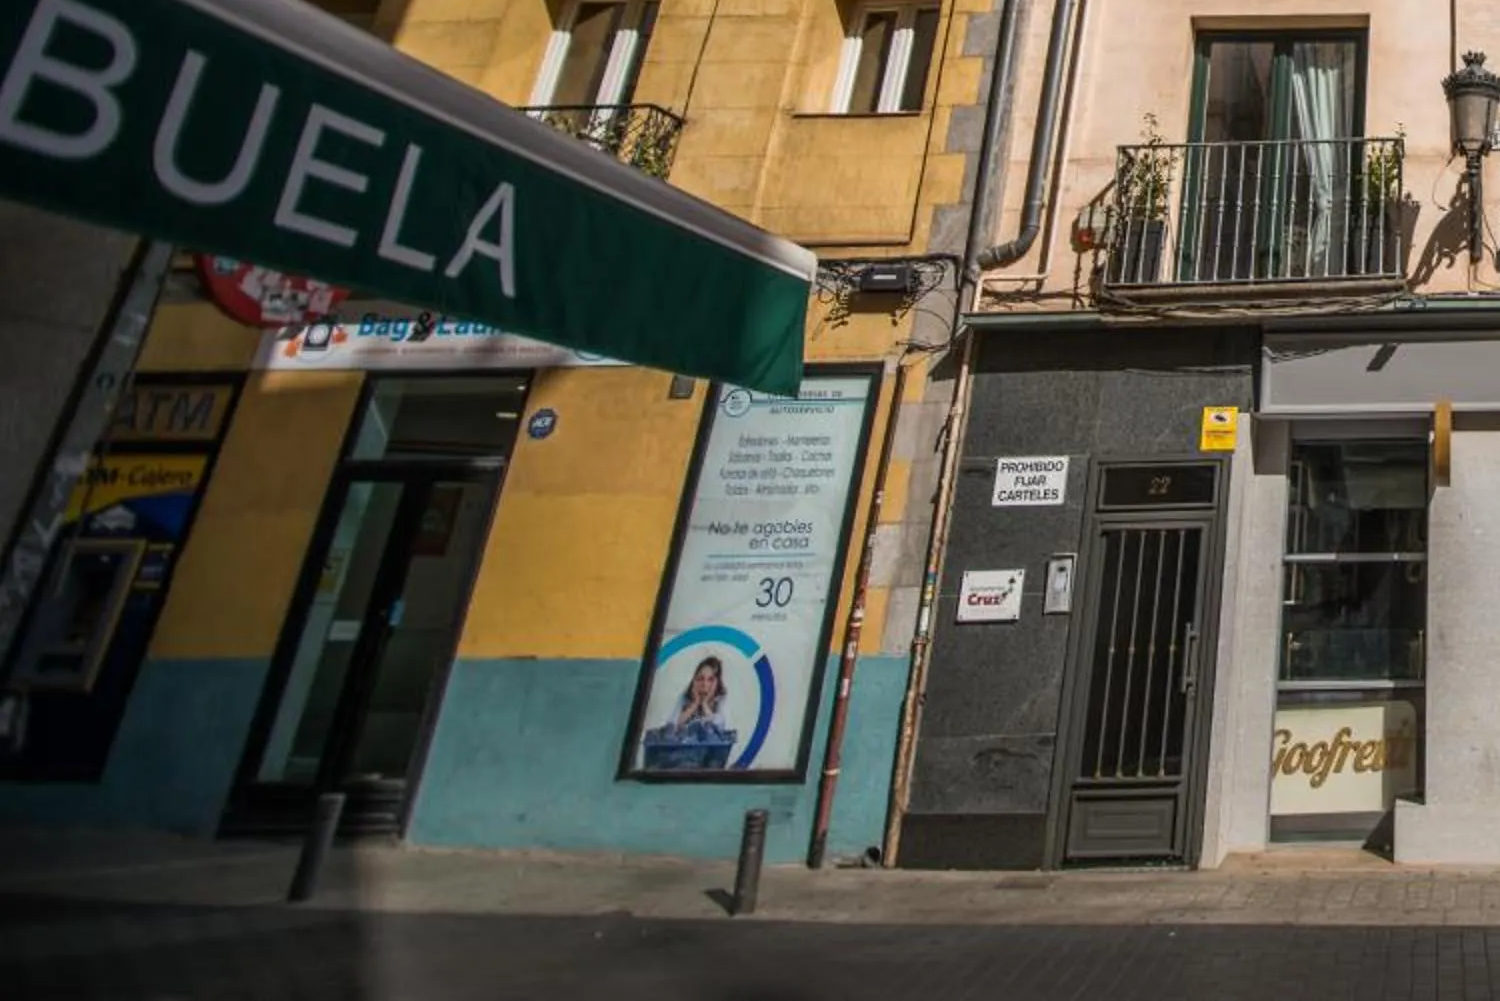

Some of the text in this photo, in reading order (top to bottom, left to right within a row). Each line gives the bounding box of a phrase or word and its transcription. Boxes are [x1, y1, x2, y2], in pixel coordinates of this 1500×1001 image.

[358, 313, 408, 342] Bag
[116, 392, 215, 434] ATM
[1000, 460, 1065, 474] PROHIBIDO
[1013, 475, 1048, 488] FIJAR
[1148, 475, 1172, 495] 22
[997, 489, 1060, 503] CARTELES
[749, 536, 810, 550] en casa
[755, 576, 795, 608] 30
[967, 594, 1003, 607] Cruz
